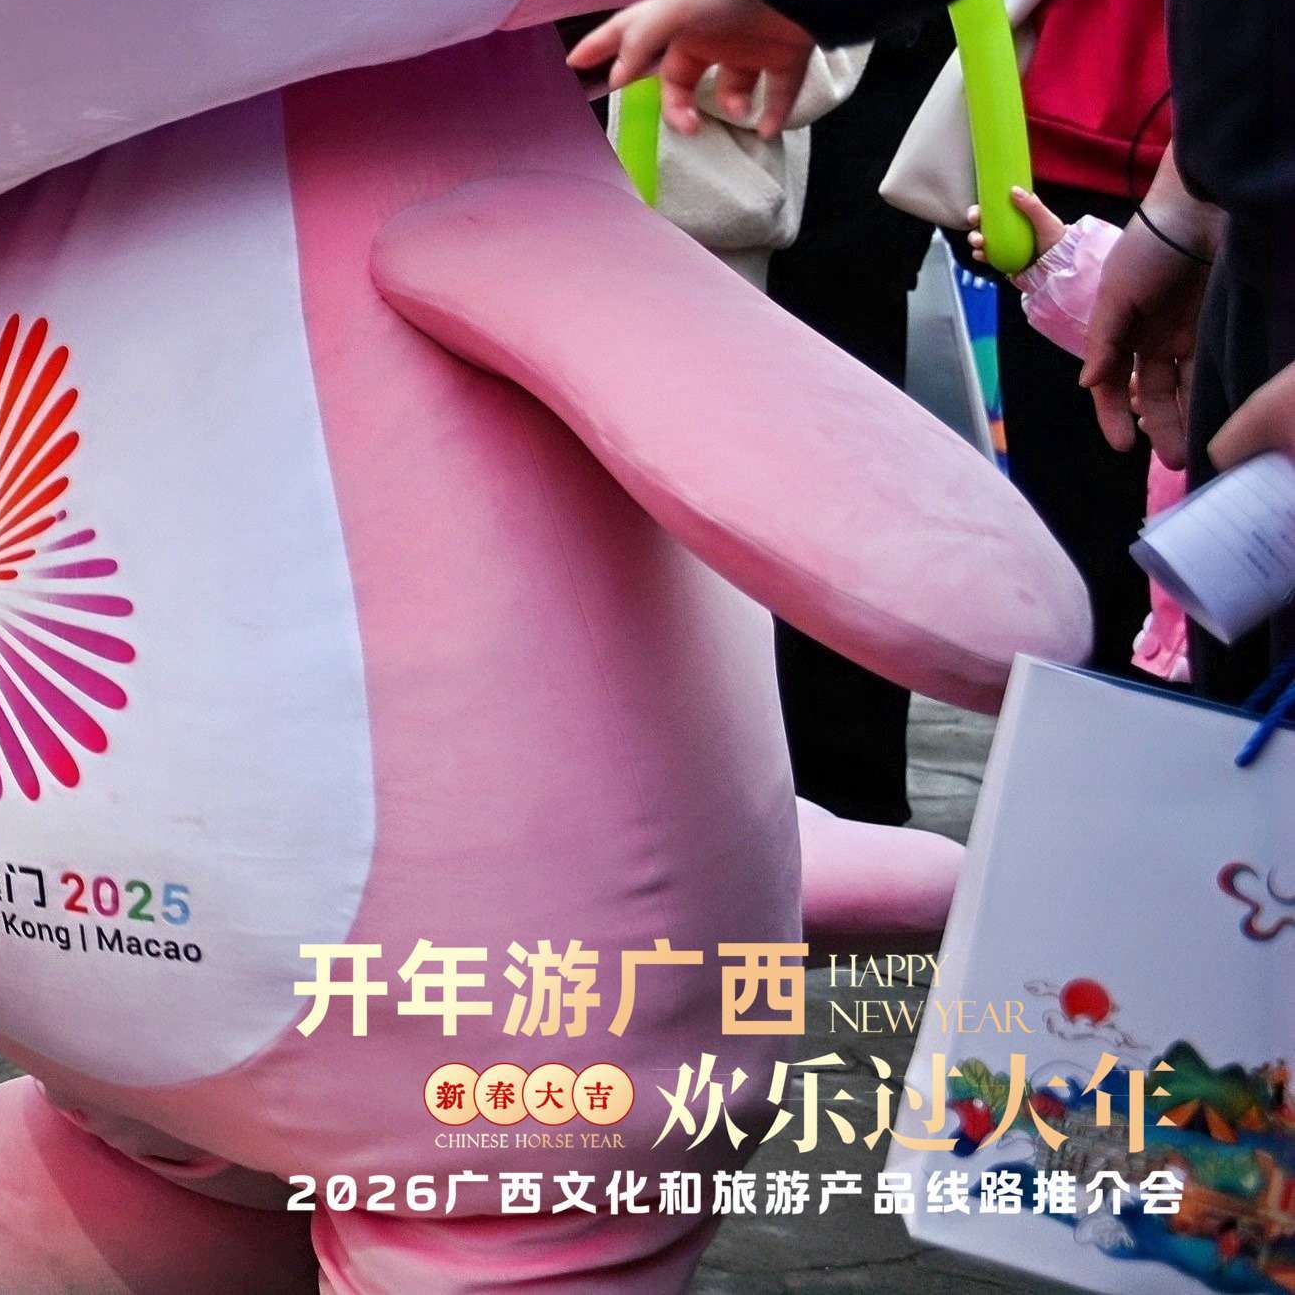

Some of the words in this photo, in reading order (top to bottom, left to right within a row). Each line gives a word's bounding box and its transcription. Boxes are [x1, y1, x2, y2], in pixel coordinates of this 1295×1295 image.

[60, 871, 192, 926] 2025
[5, 911, 72, 951] Kong
[97, 927, 202, 964] Macao
